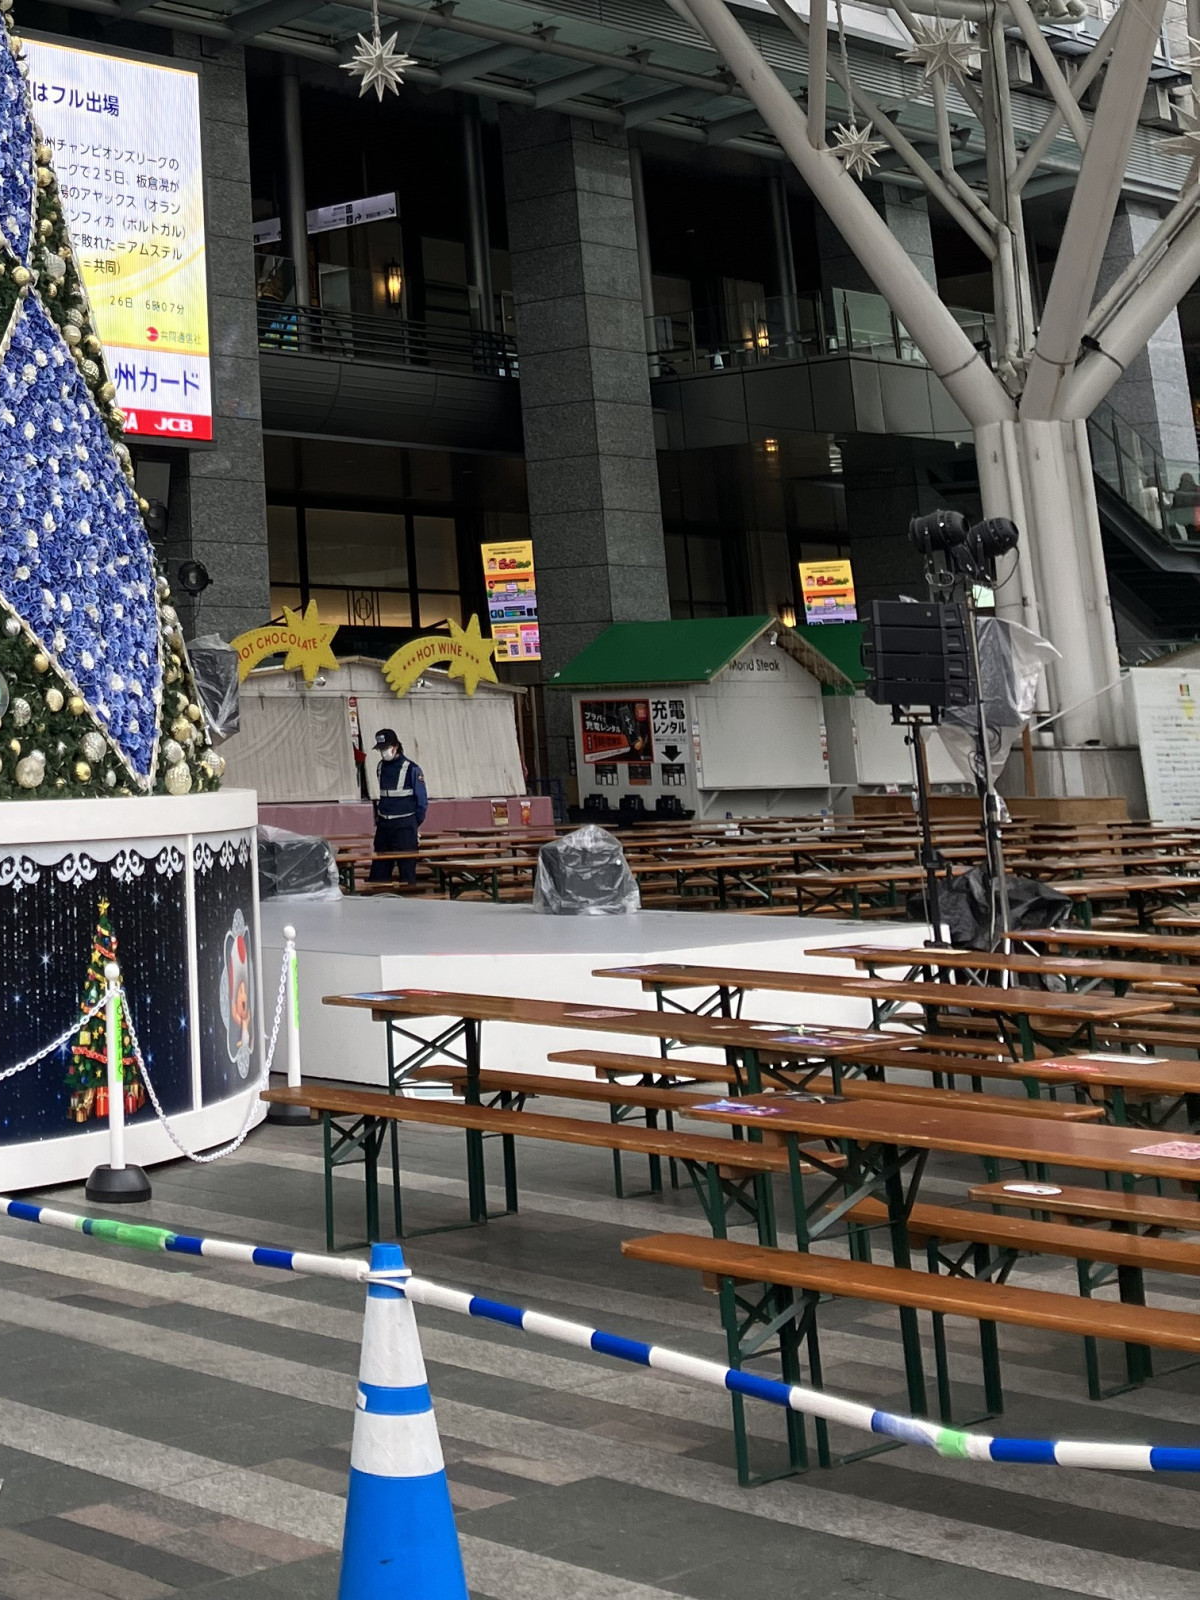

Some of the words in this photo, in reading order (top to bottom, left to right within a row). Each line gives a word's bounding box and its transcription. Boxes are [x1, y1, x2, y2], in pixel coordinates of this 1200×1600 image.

[154, 417, 193, 433] JCB
[256, 632, 318, 651] CHOCOLATE
[416, 643, 436, 661] HOT
[438, 643, 462, 657] WINE
[755, 659, 780, 672] Steak
[651, 700, 686, 720] 充電
[653, 721, 686, 735] レンタル
